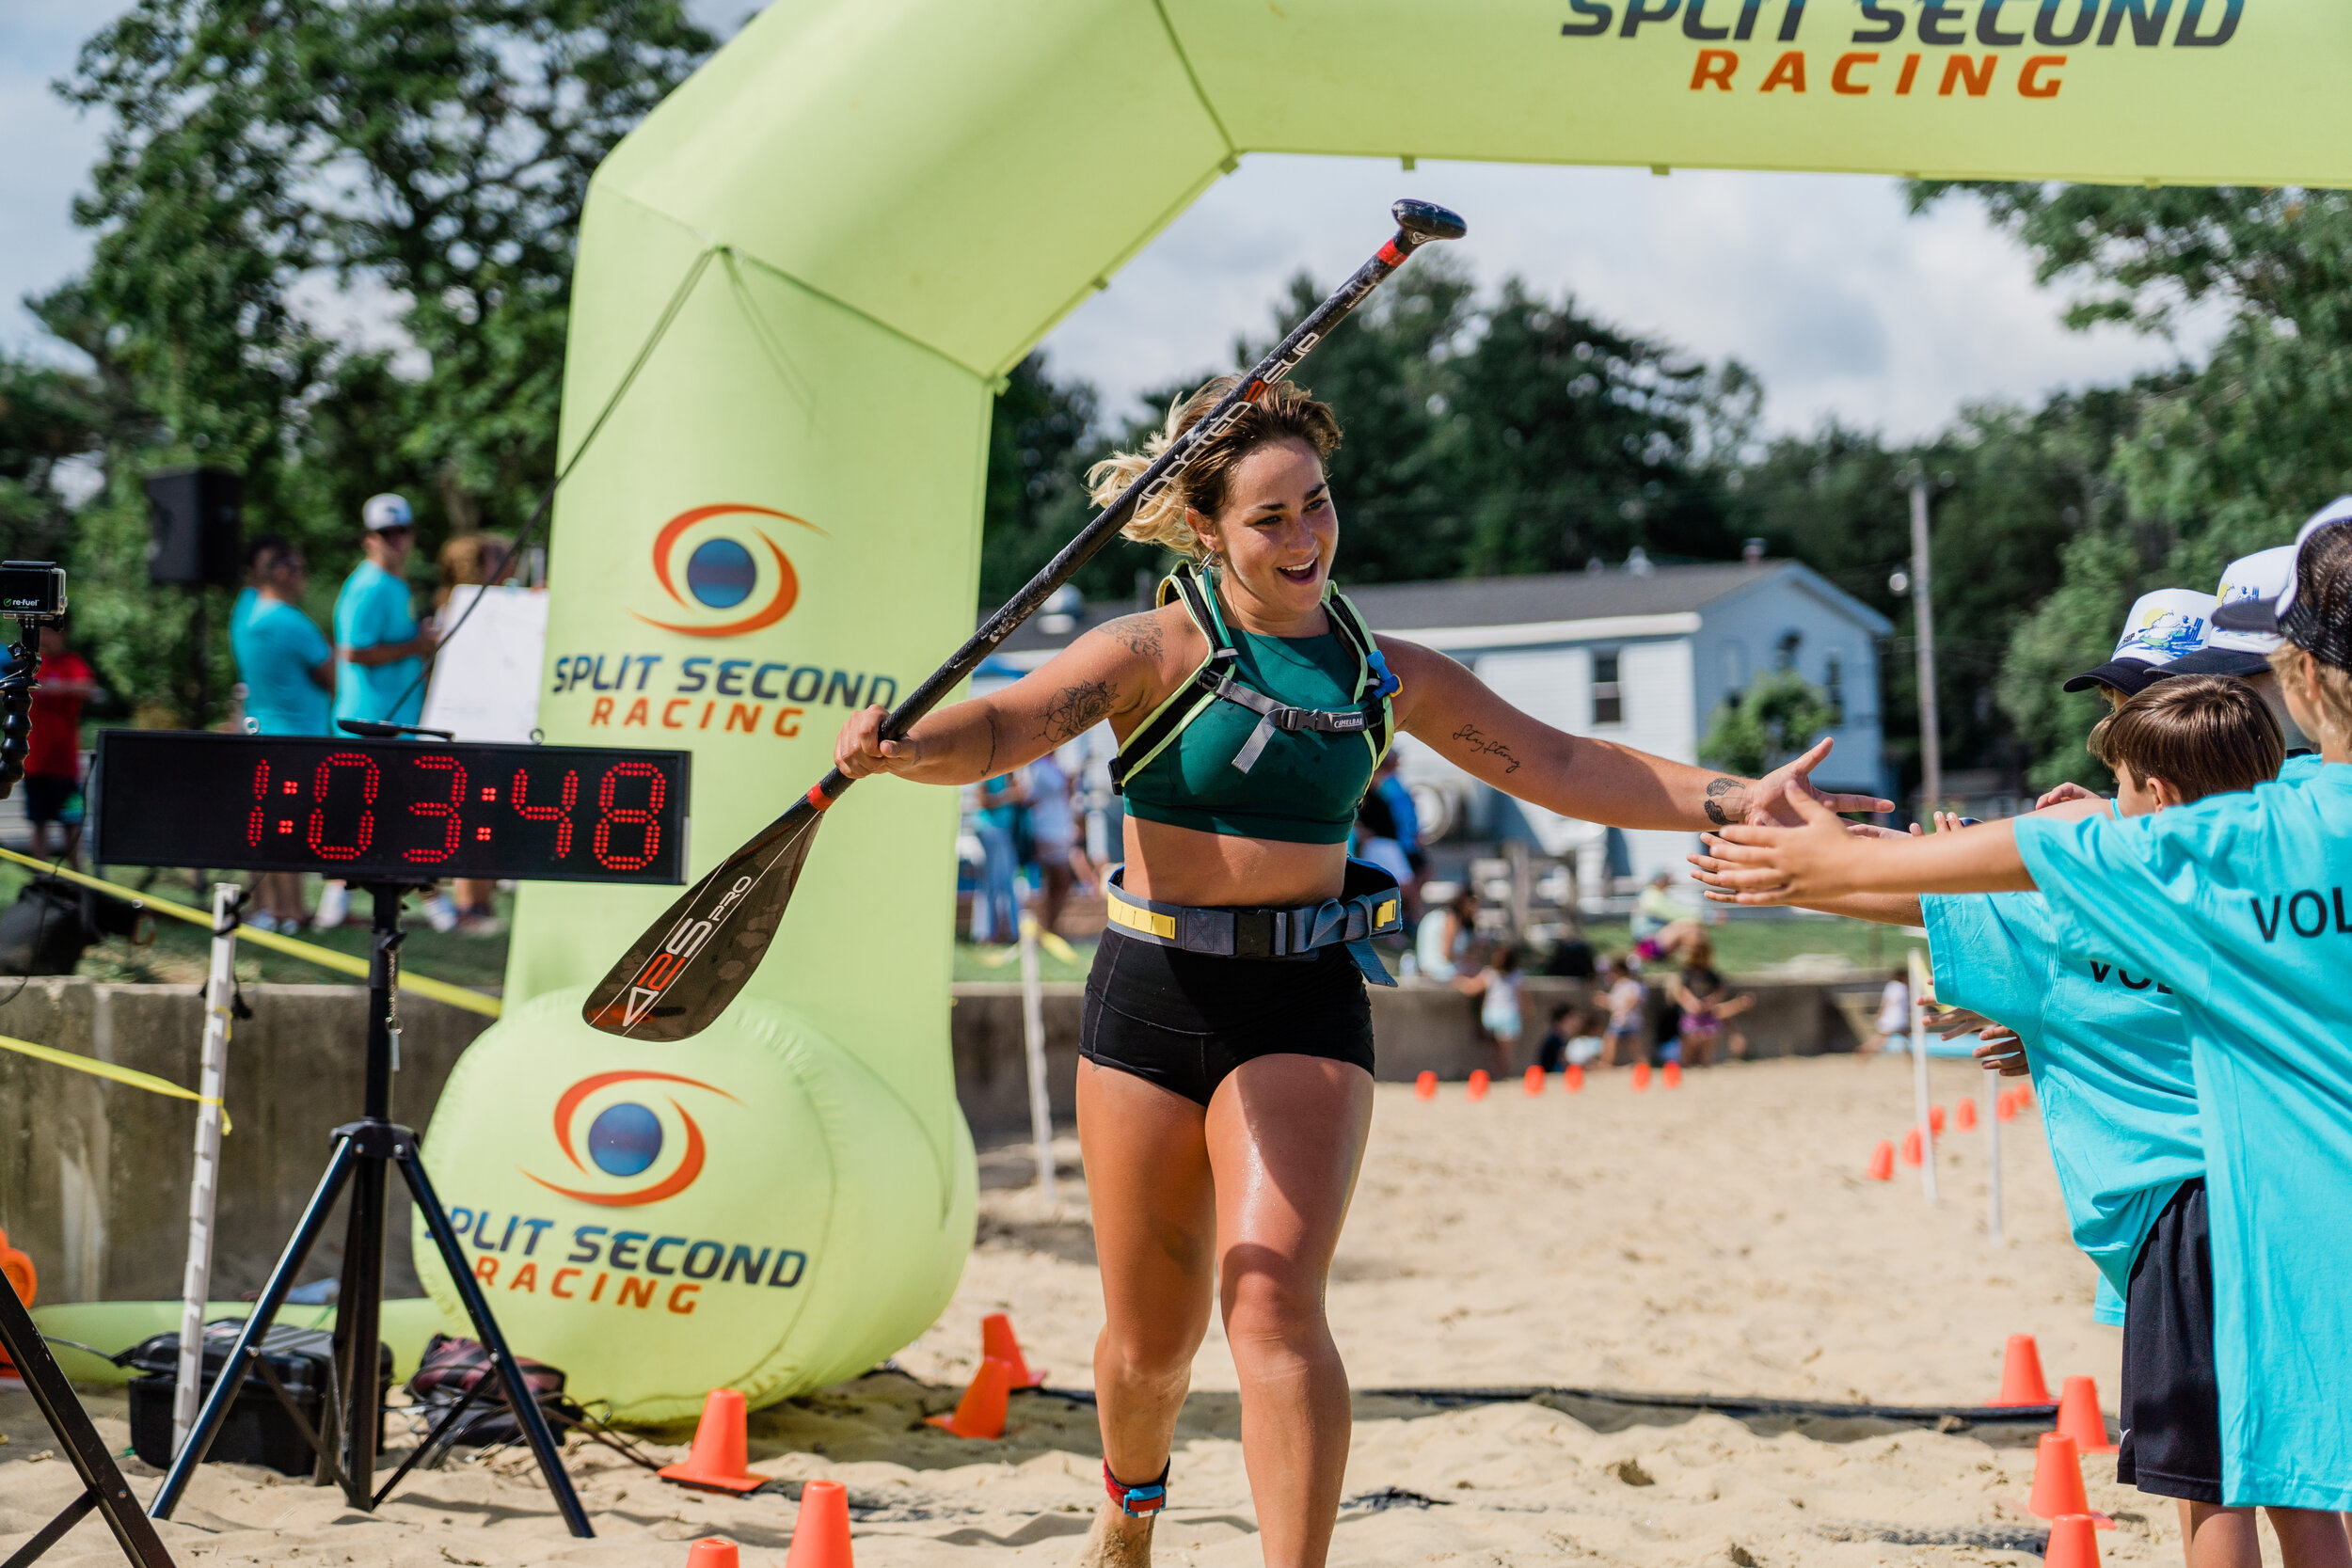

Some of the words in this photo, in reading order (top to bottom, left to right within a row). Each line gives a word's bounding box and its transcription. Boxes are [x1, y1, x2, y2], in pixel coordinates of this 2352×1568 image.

[1851, 0, 2245, 46] SECOND
[1689, 49, 2068, 98] RACING
[553, 654, 662, 693] SPLIT
[677, 658, 898, 710] SECOND
[590, 696, 804, 738] RACING
[247, 752, 667, 871] 1:03:48
[707, 876, 752, 922] PRO
[424, 1205, 555, 1257] PLIT
[567, 1226, 808, 1290] SECOND
[473, 1255, 703, 1316] RACING
